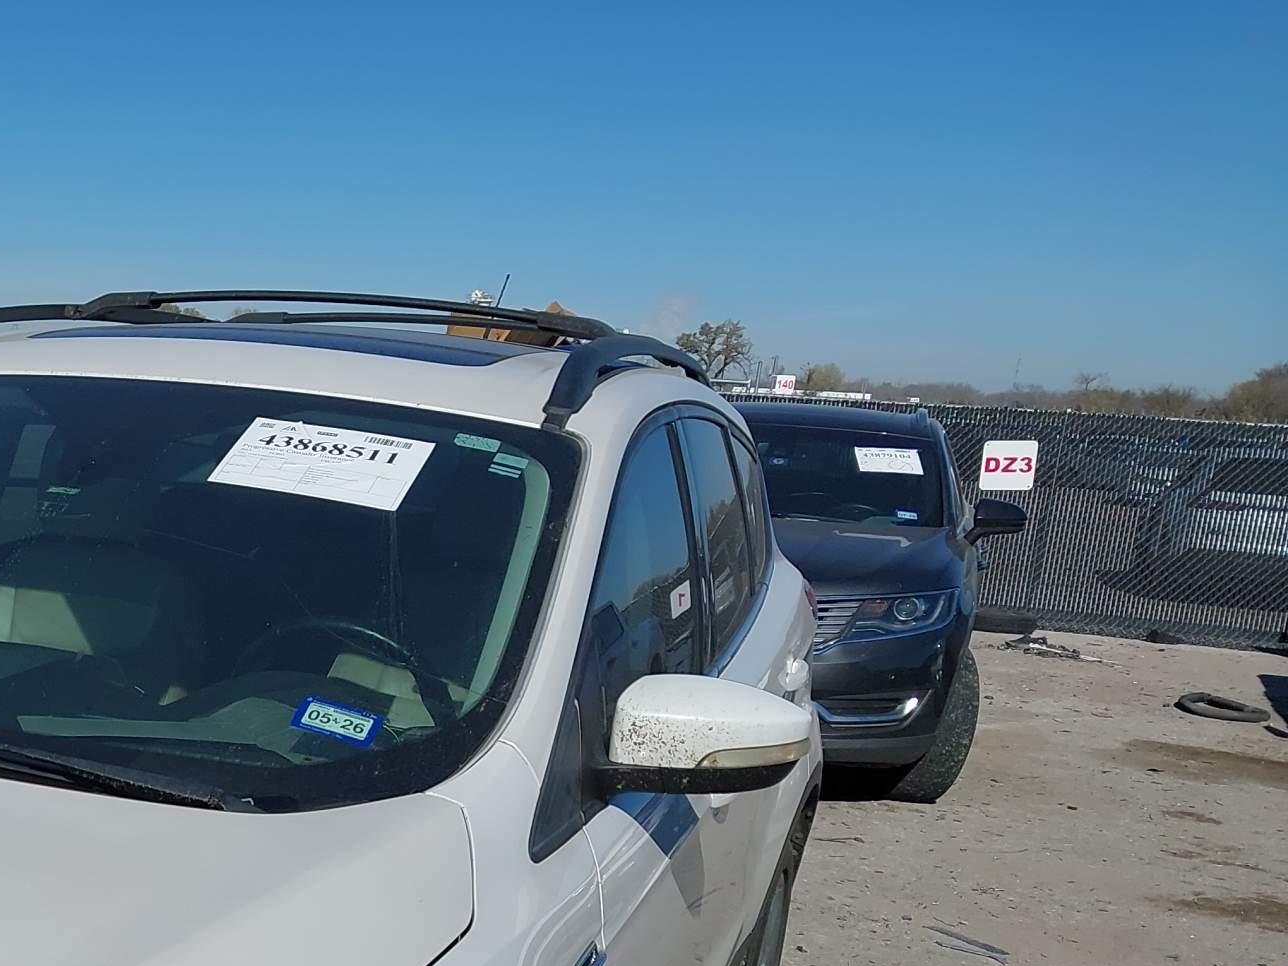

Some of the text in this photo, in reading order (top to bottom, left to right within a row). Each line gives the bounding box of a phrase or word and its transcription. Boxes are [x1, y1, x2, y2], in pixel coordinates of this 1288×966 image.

[777, 380, 794, 390] 140
[258, 434, 400, 465] 43868511
[985, 456, 1033, 473] DZ3
